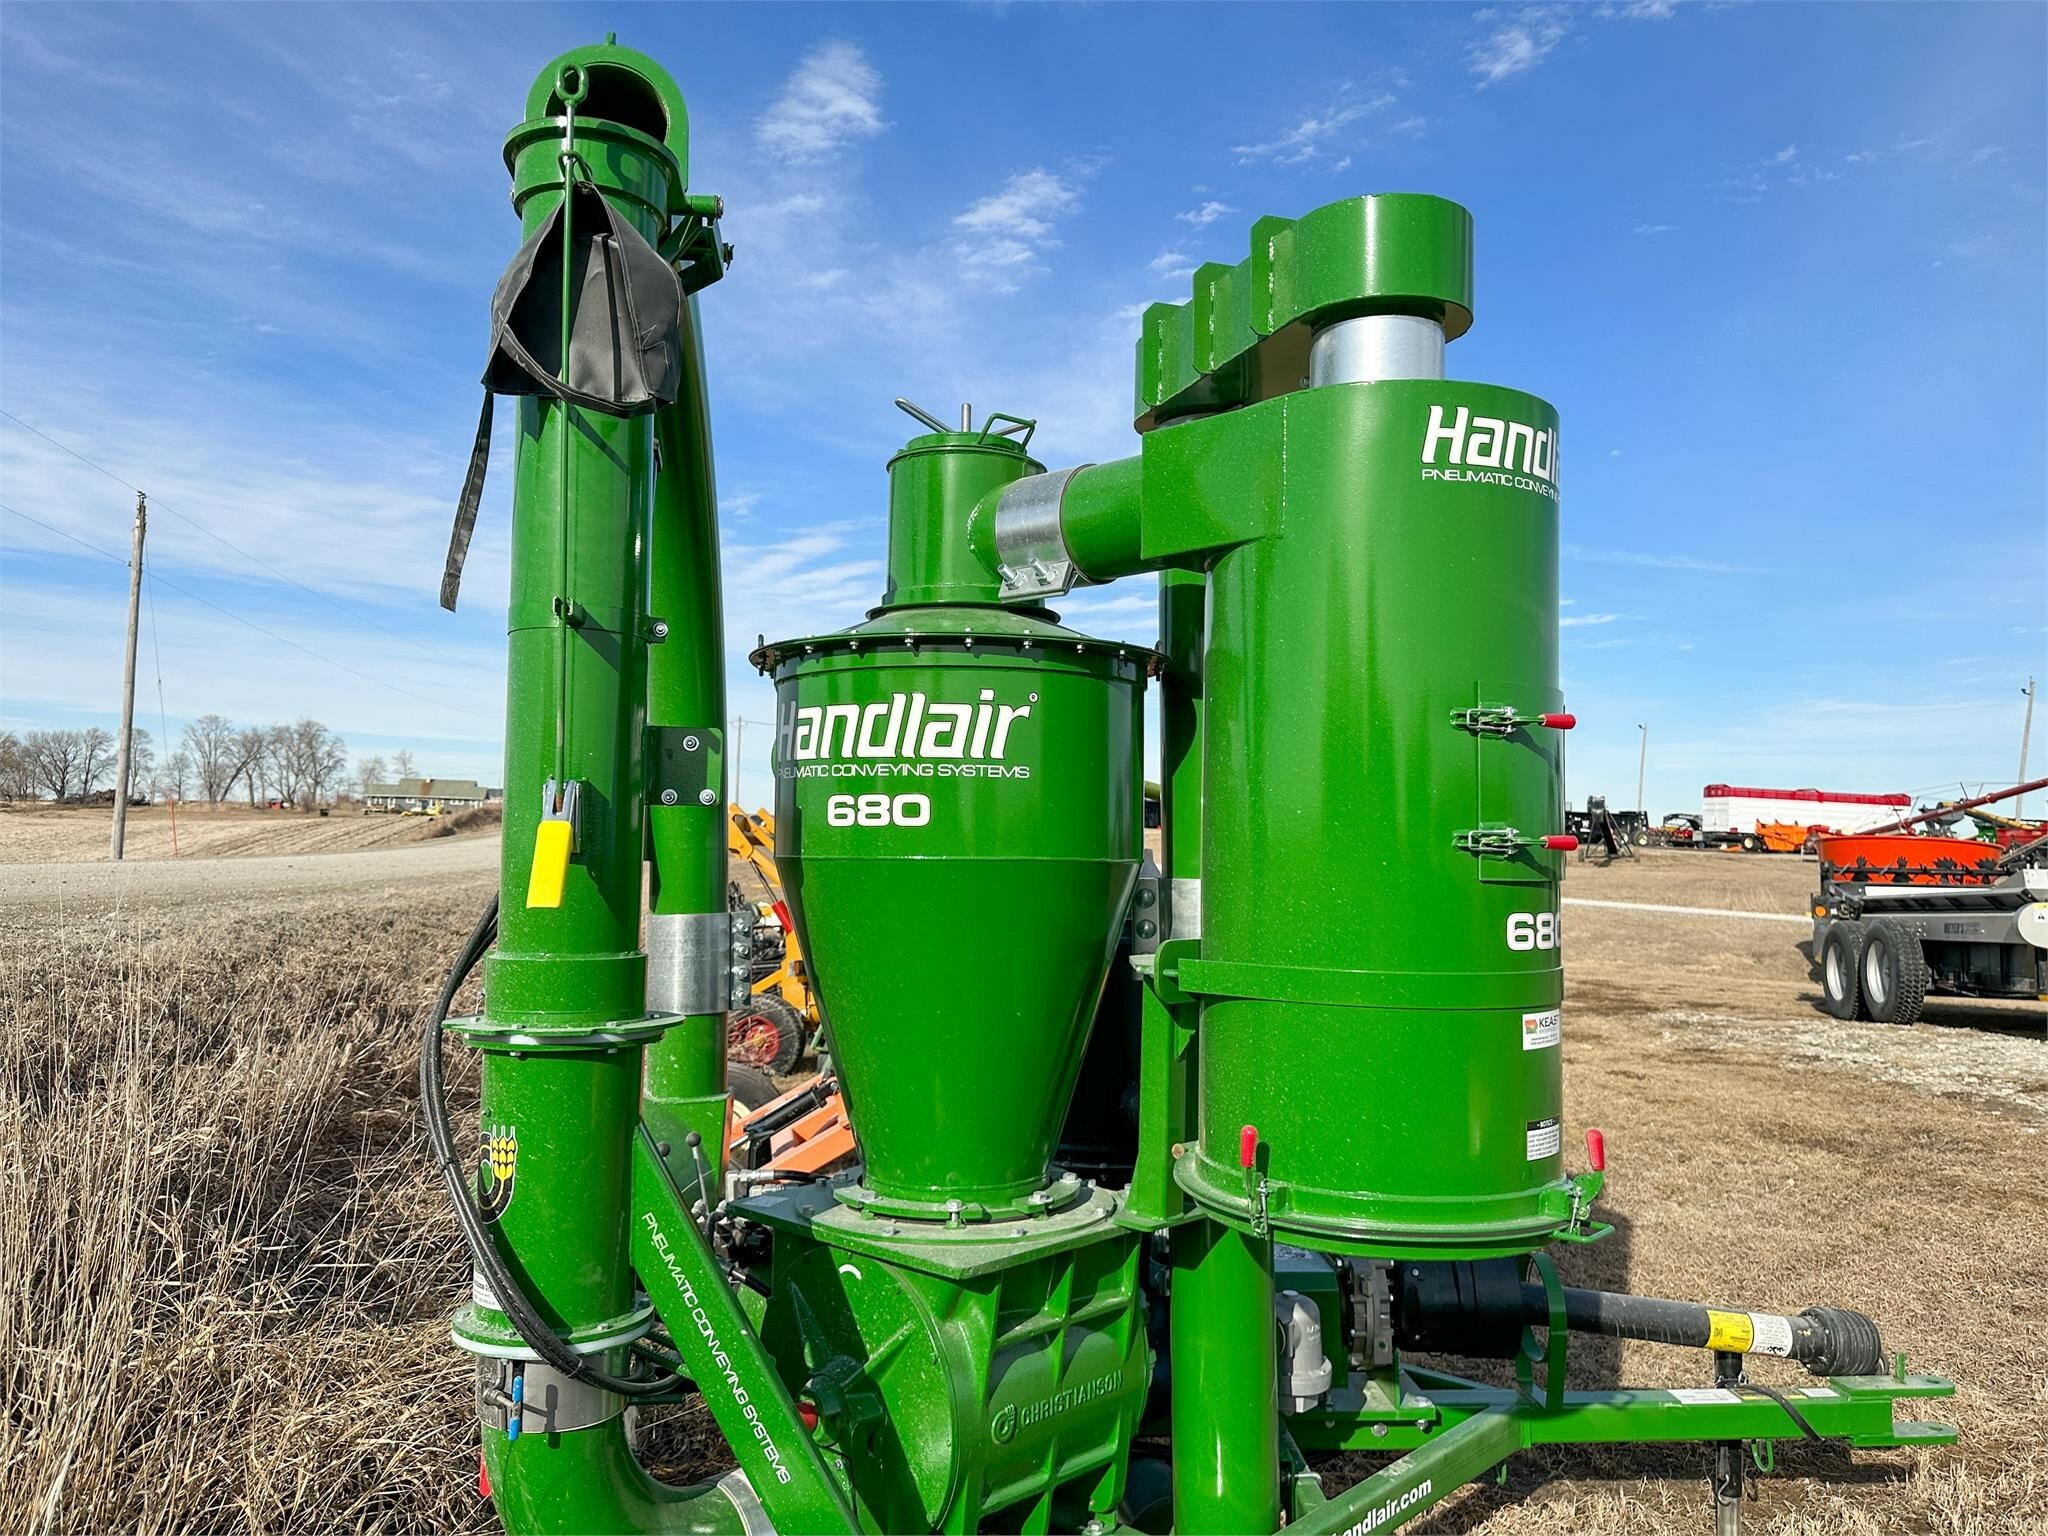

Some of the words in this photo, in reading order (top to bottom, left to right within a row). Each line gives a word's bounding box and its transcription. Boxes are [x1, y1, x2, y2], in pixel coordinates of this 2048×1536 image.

[1422, 469, 1514, 488] PNEUMATIC
[777, 764, 829, 779] PNEUMATIC
[831, 764, 934, 778] CONVEYING
[937, 764, 1031, 779] SYSTEMS
[827, 793, 931, 828] 680
[641, 1211, 699, 1308] PNEUMATIC
[692, 1307, 750, 1405] CONVEYING
[742, 1401, 791, 1485] SYSTEMS
[1020, 1369, 1124, 1427] CHRISTIANSON
